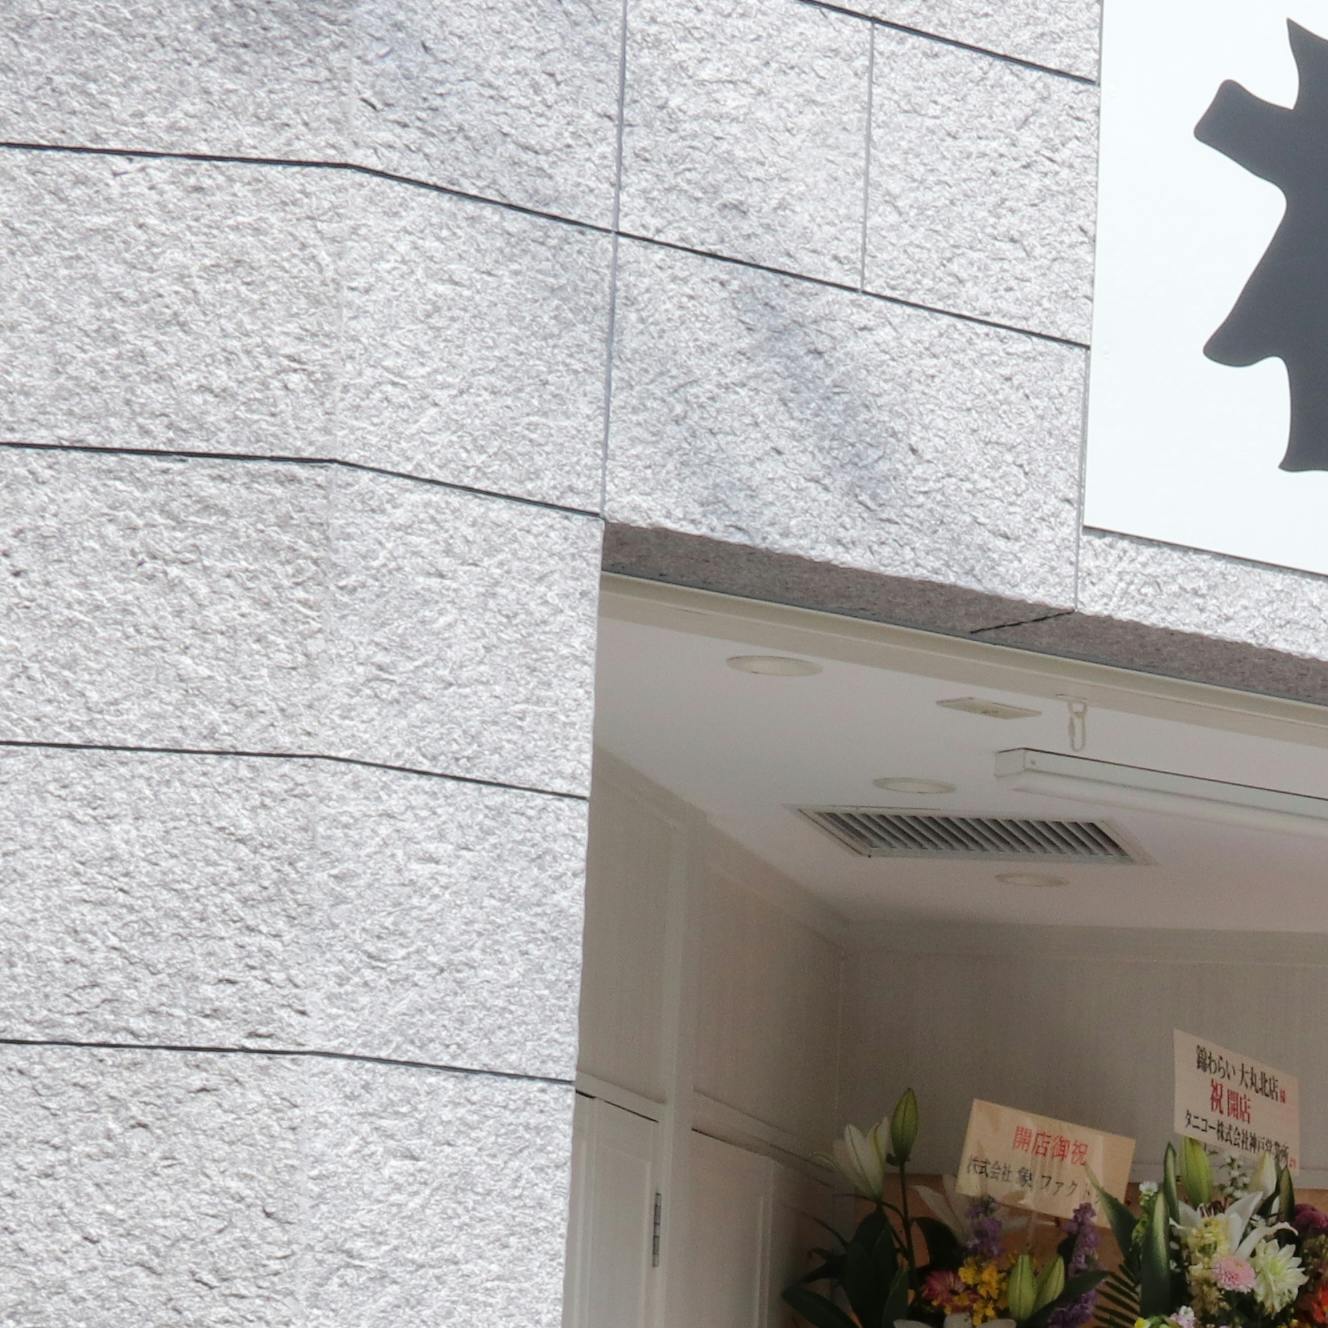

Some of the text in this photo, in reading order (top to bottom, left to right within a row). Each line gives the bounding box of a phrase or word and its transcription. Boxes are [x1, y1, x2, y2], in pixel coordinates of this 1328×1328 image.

[1210, 1078, 1251, 1125] 祝 開店
[1013, 1125, 1089, 1166] 開店御祝
